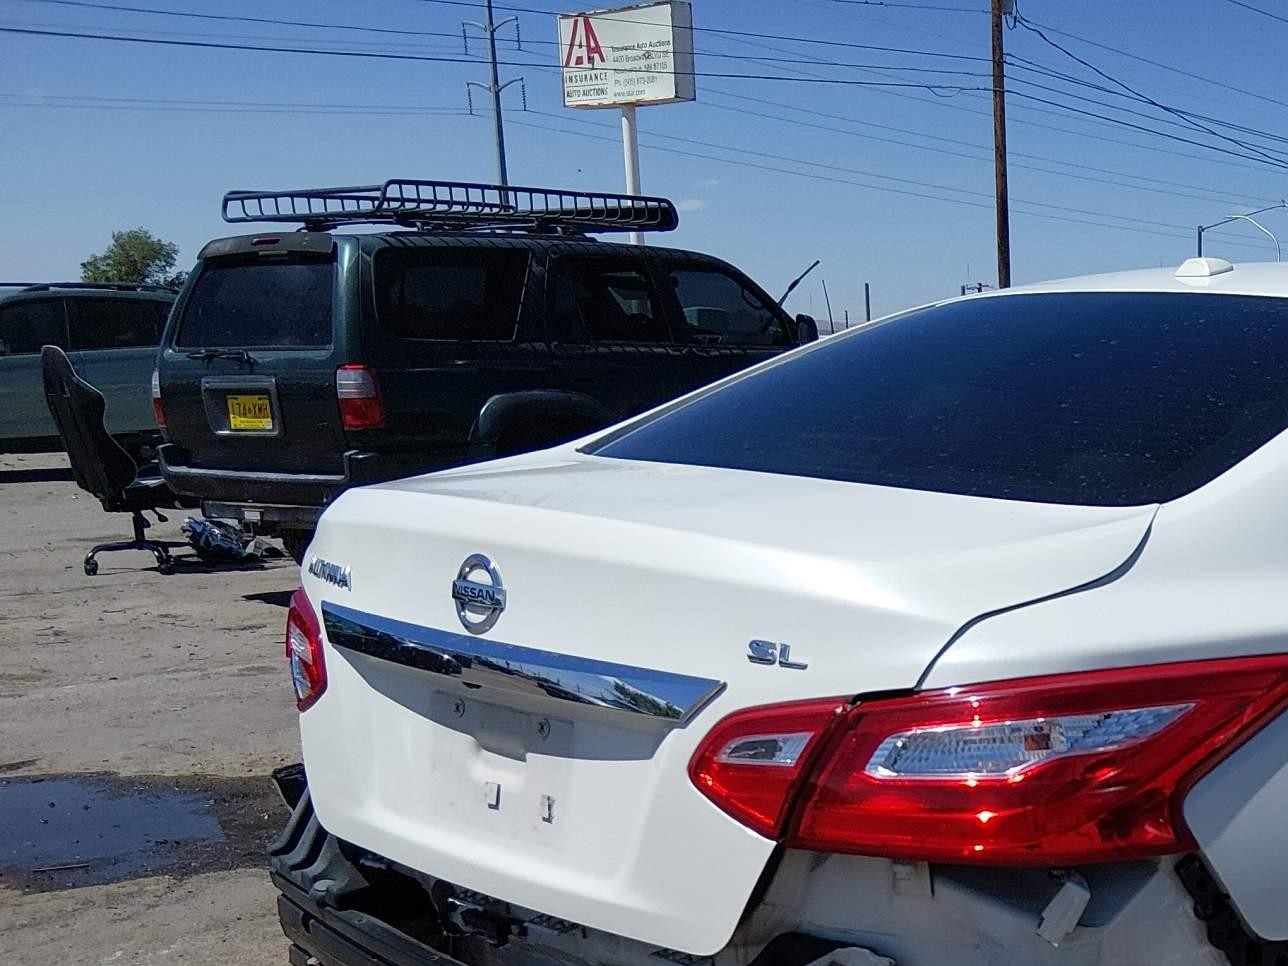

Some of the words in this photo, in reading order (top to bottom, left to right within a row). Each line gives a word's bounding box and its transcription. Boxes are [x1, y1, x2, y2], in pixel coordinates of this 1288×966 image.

[565, 72, 608, 84] INSURANCE
[566, 88, 581, 98] AUTO
[581, 86, 608, 97] AUCTIONS
[455, 584, 496, 602] NISSAN
[747, 639, 809, 670] SL
